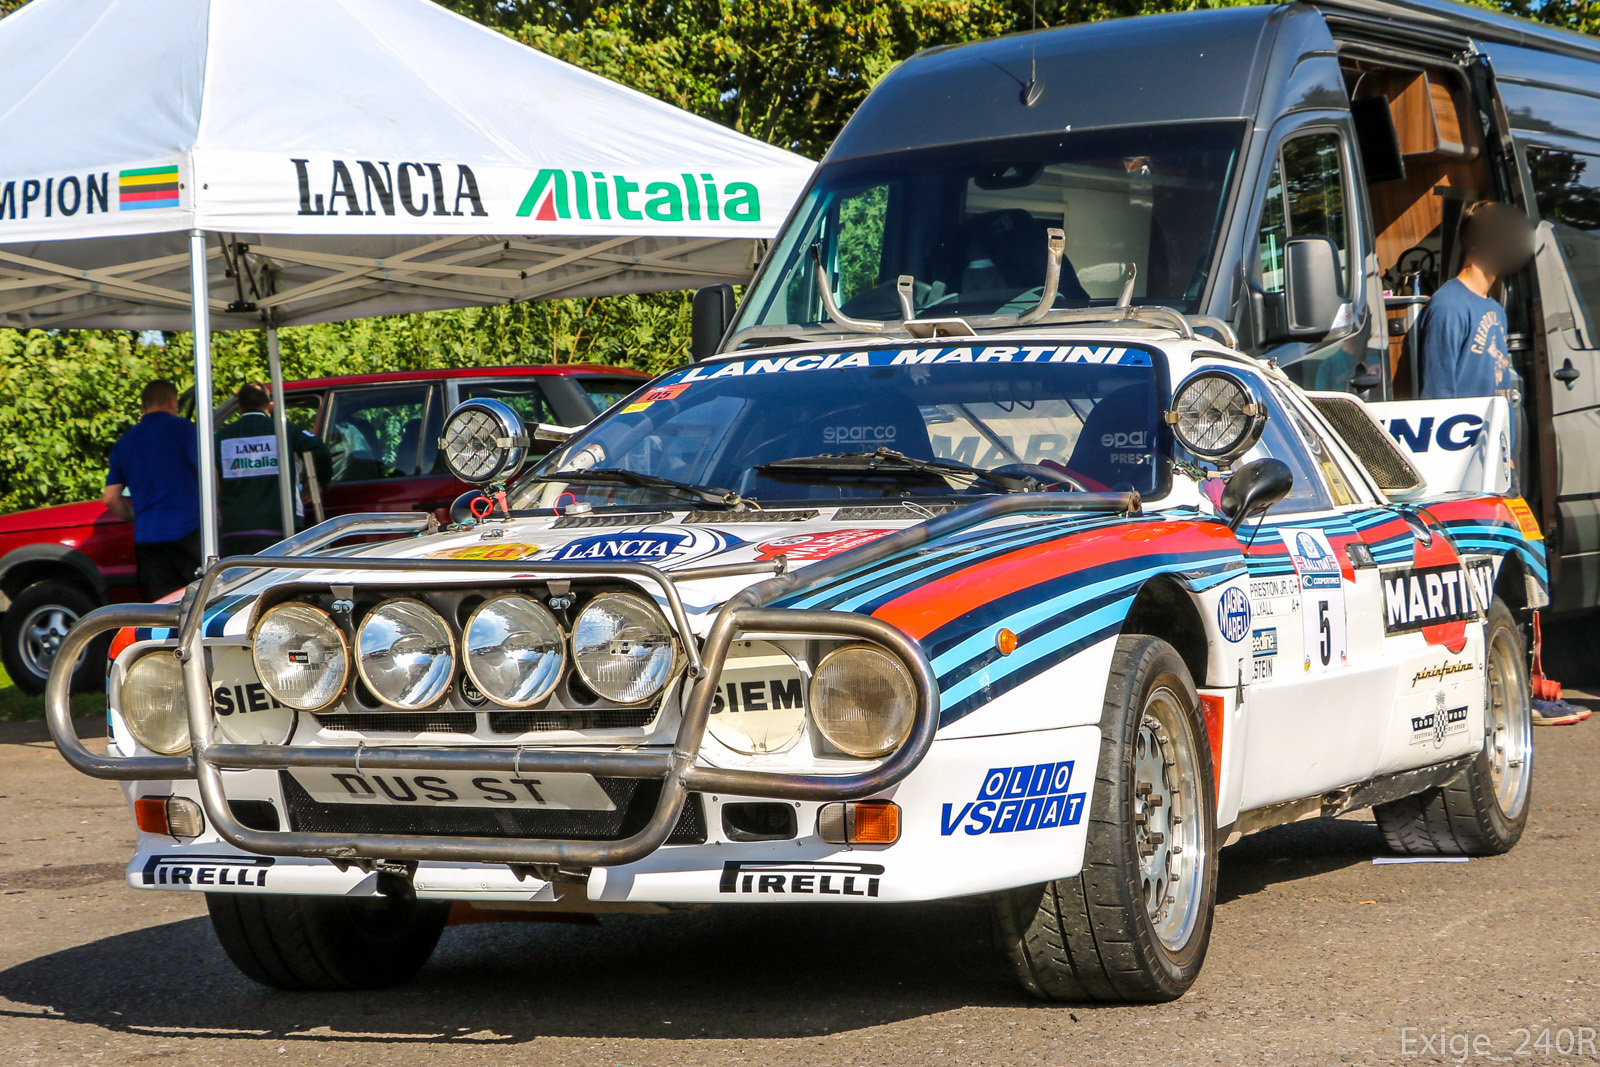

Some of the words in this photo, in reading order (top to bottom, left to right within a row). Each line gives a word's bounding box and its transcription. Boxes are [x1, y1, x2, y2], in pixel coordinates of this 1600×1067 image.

[290, 158, 489, 217] LANCIA
[515, 168, 761, 222] Alitalia
[679, 351, 869, 384] LANCIA
[889, 345, 1128, 365] MARTINI
[235, 443, 271, 454] LANCIA
[822, 425, 897, 445] sparco
[1380, 413, 1483, 453] NG
[230, 456, 279, 470] Alitalia
[931, 433, 1079, 470] MAR
[562, 540, 669, 560] LANCIA
[1250, 581, 1279, 598] PRESTON
[1318, 600, 1332, 667] 5
[1412, 660, 1474, 688] pininfarina
[214, 683, 284, 716] SIE
[1413, 717, 1434, 730] GOOD
[1448, 709, 1468, 721] WOOD
[980, 763, 1073, 799] OLIO
[142, 854, 277, 888] PIRELLI
[719, 860, 886, 898] PIRELLI
